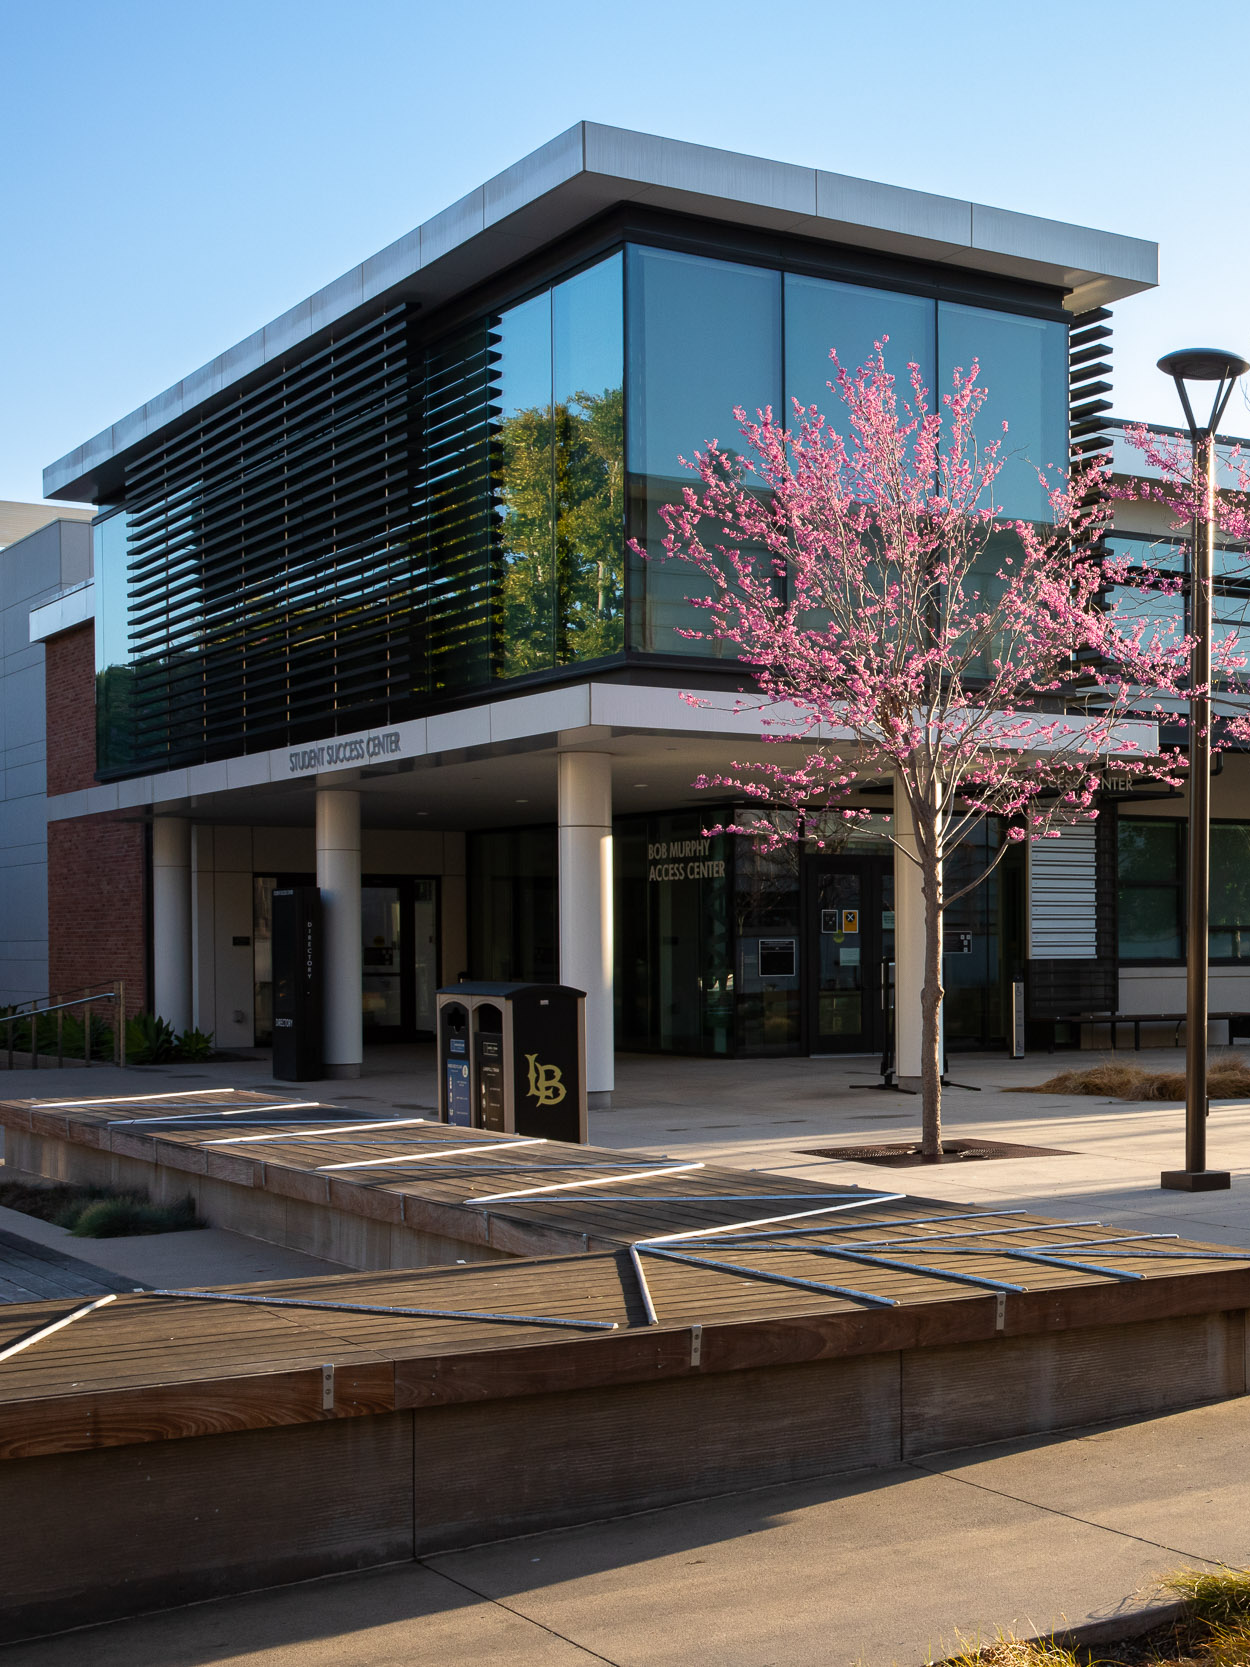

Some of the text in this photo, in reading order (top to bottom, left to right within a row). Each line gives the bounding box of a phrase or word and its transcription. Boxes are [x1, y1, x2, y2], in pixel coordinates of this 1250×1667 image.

[289, 731, 401, 772] STUDENT SUCCESS CENTER
[1084, 775, 1134, 791] CNTER
[648, 839, 710, 860] BOB MURPHY
[649, 860, 725, 881] ACCESS CENTER
[275, 1018, 293, 1027] DIRECTORY
